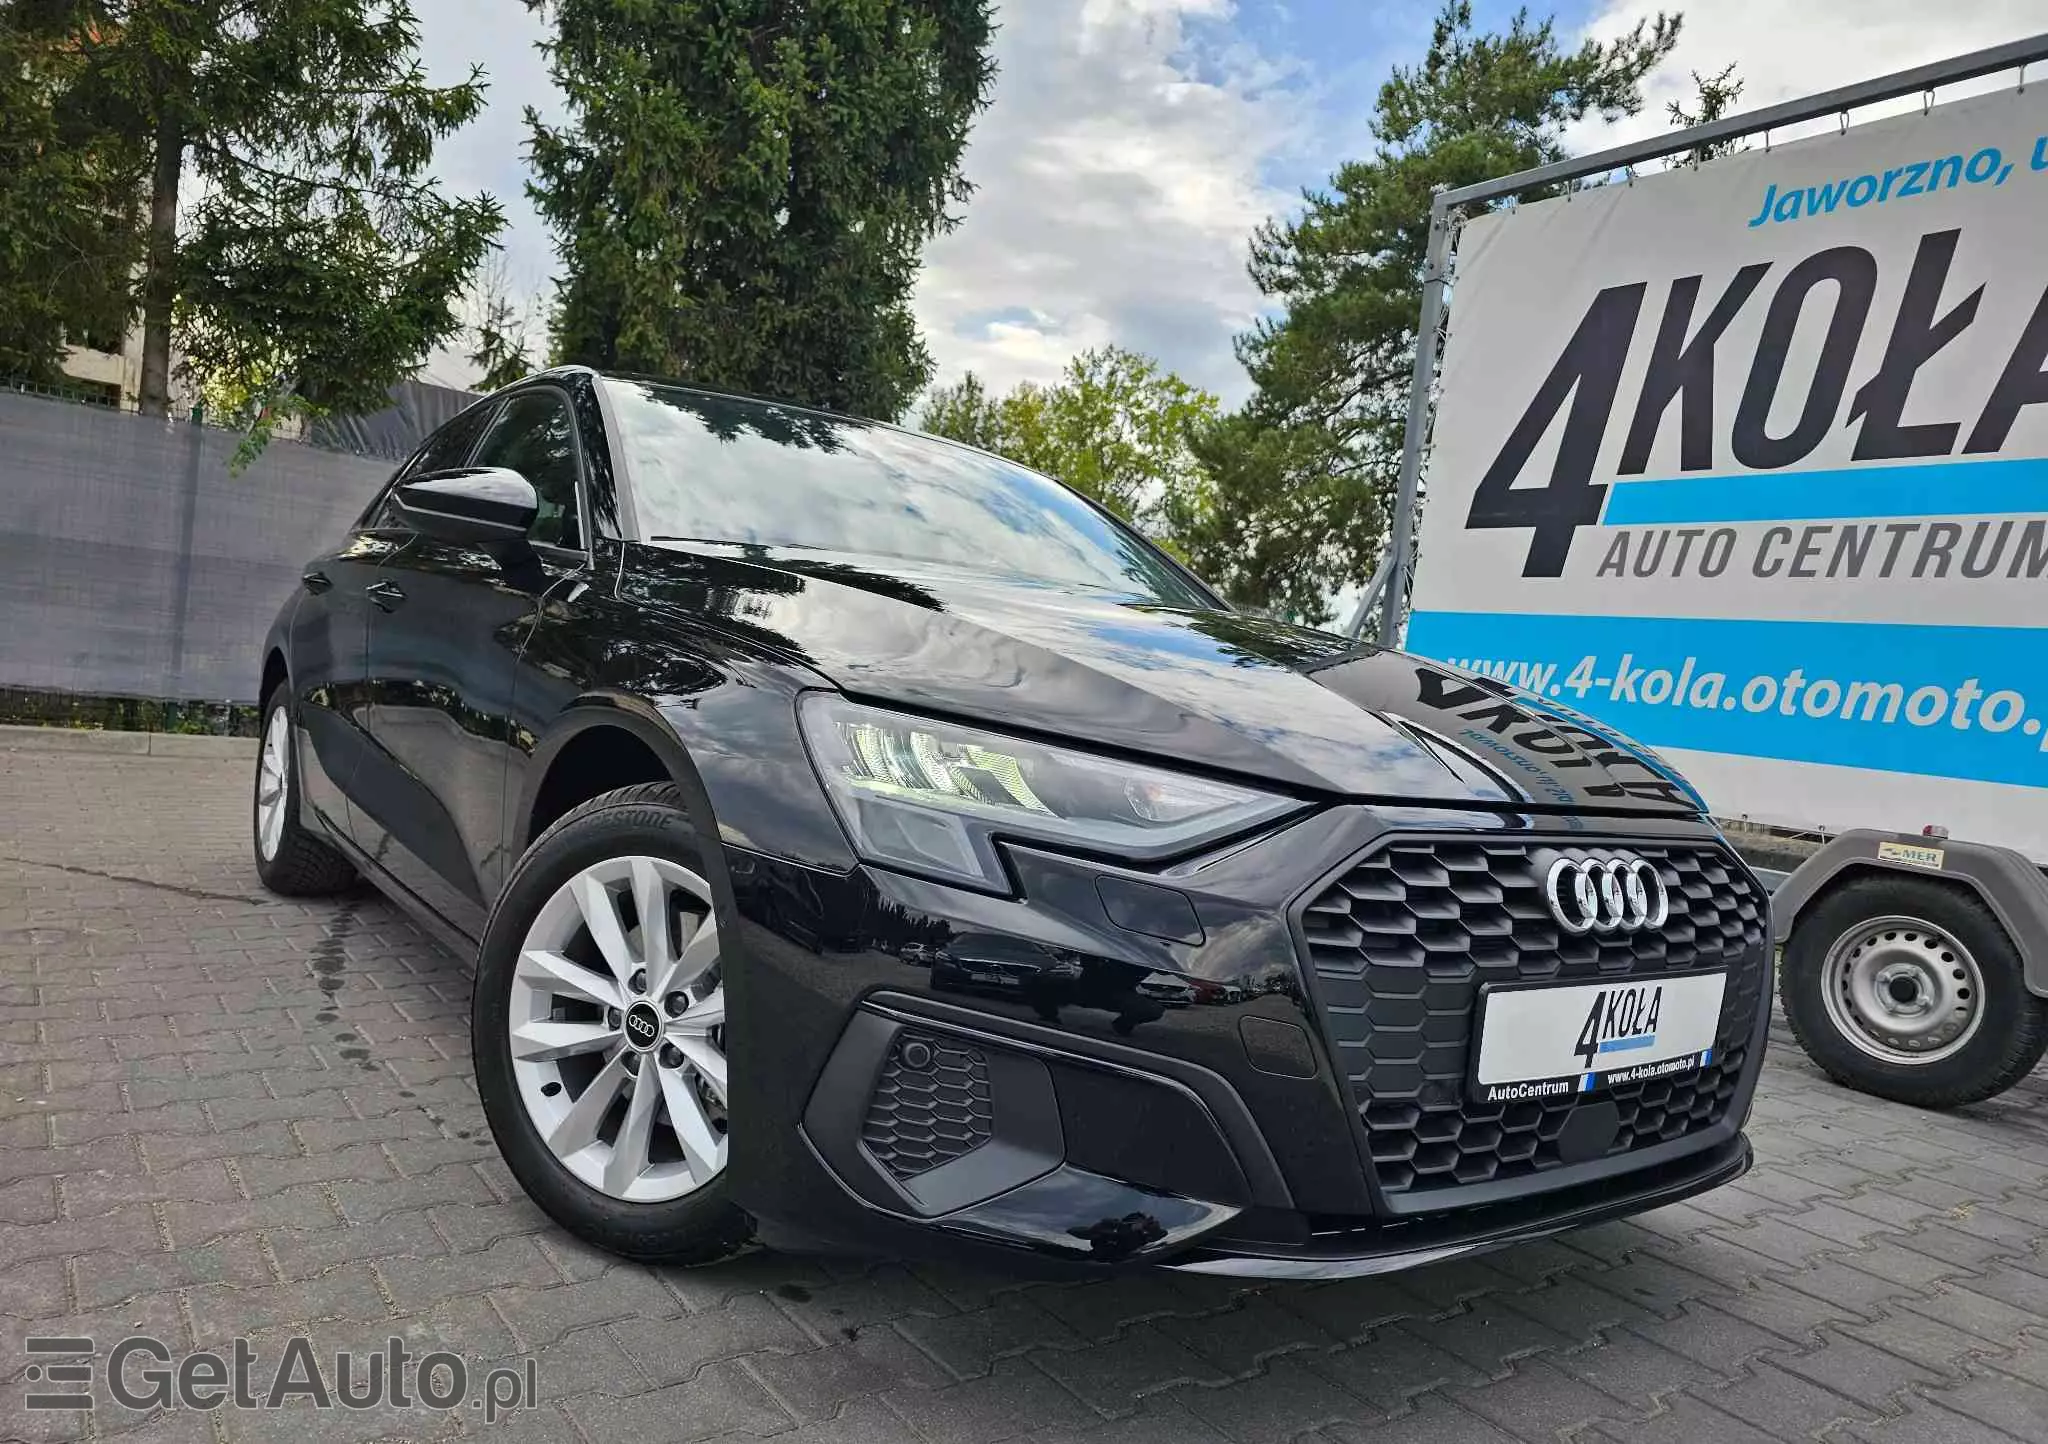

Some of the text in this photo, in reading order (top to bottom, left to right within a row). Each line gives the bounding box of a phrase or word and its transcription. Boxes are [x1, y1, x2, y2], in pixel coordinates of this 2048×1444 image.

[1748, 147, 2016, 227] Jaworzno,
[1597, 528, 1737, 577] AUTO
[1447, 653, 2048, 752] ww.4-kola.otomoto.
[1488, 1055, 1695, 1101] AutoCentrum www.4-kola.otomoto.pl
